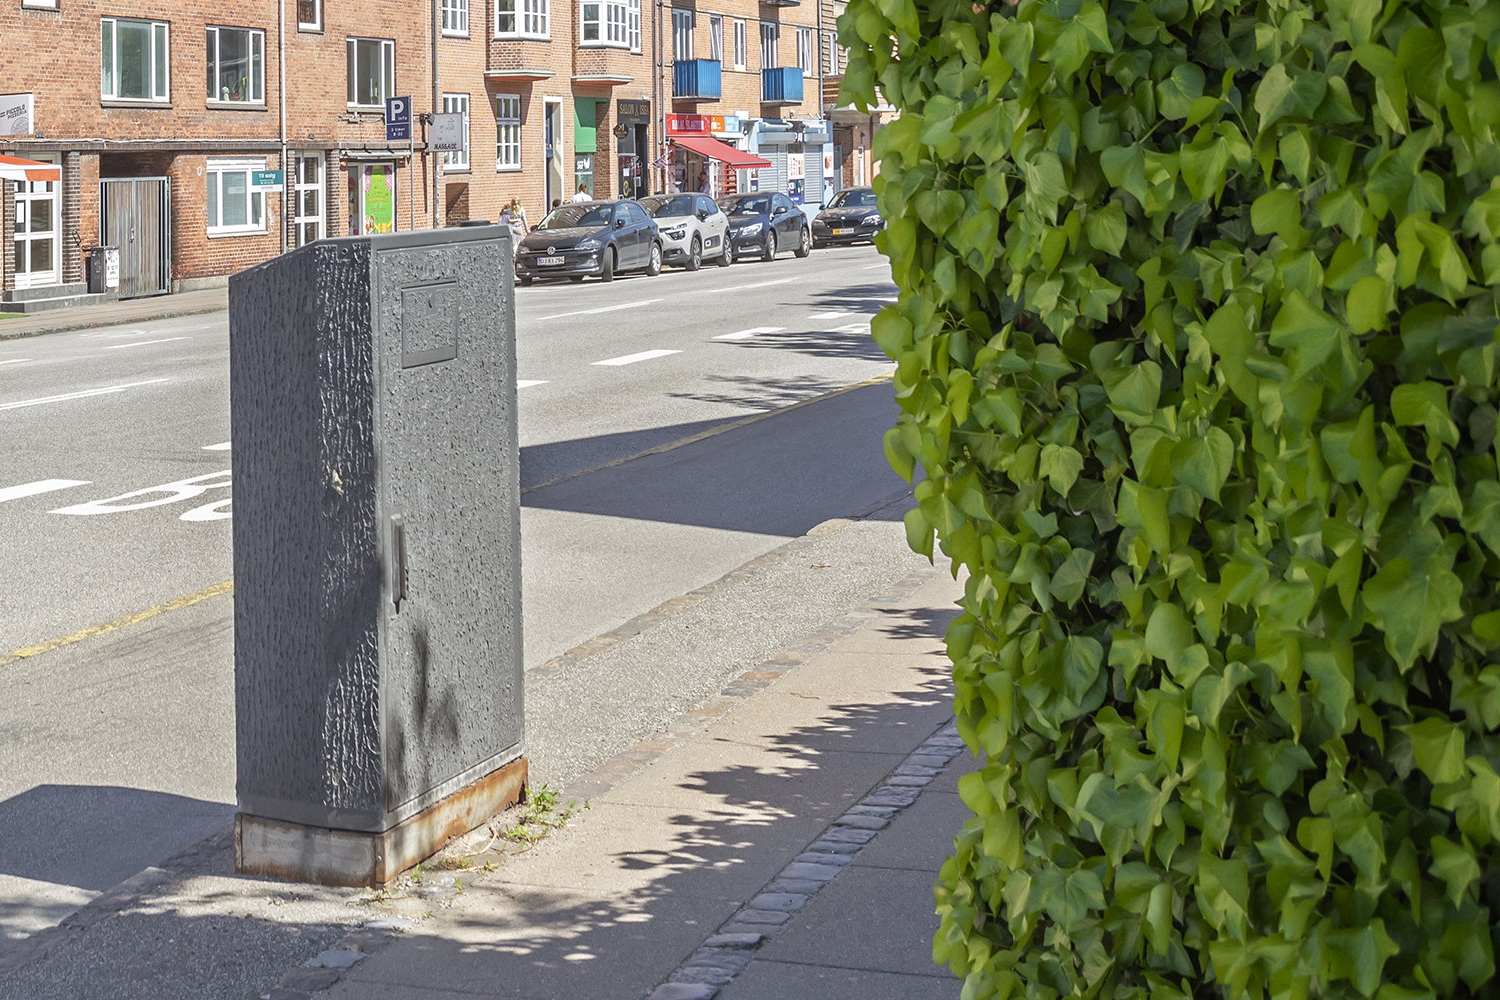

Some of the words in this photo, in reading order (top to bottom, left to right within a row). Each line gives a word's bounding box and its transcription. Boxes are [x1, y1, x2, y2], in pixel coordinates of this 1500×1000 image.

[6, 104, 26, 116] PICCOLO
[7, 109, 27, 120] PIZZERIA
[391, 100, 404, 121] P
[619, 103, 635, 115] SALON
